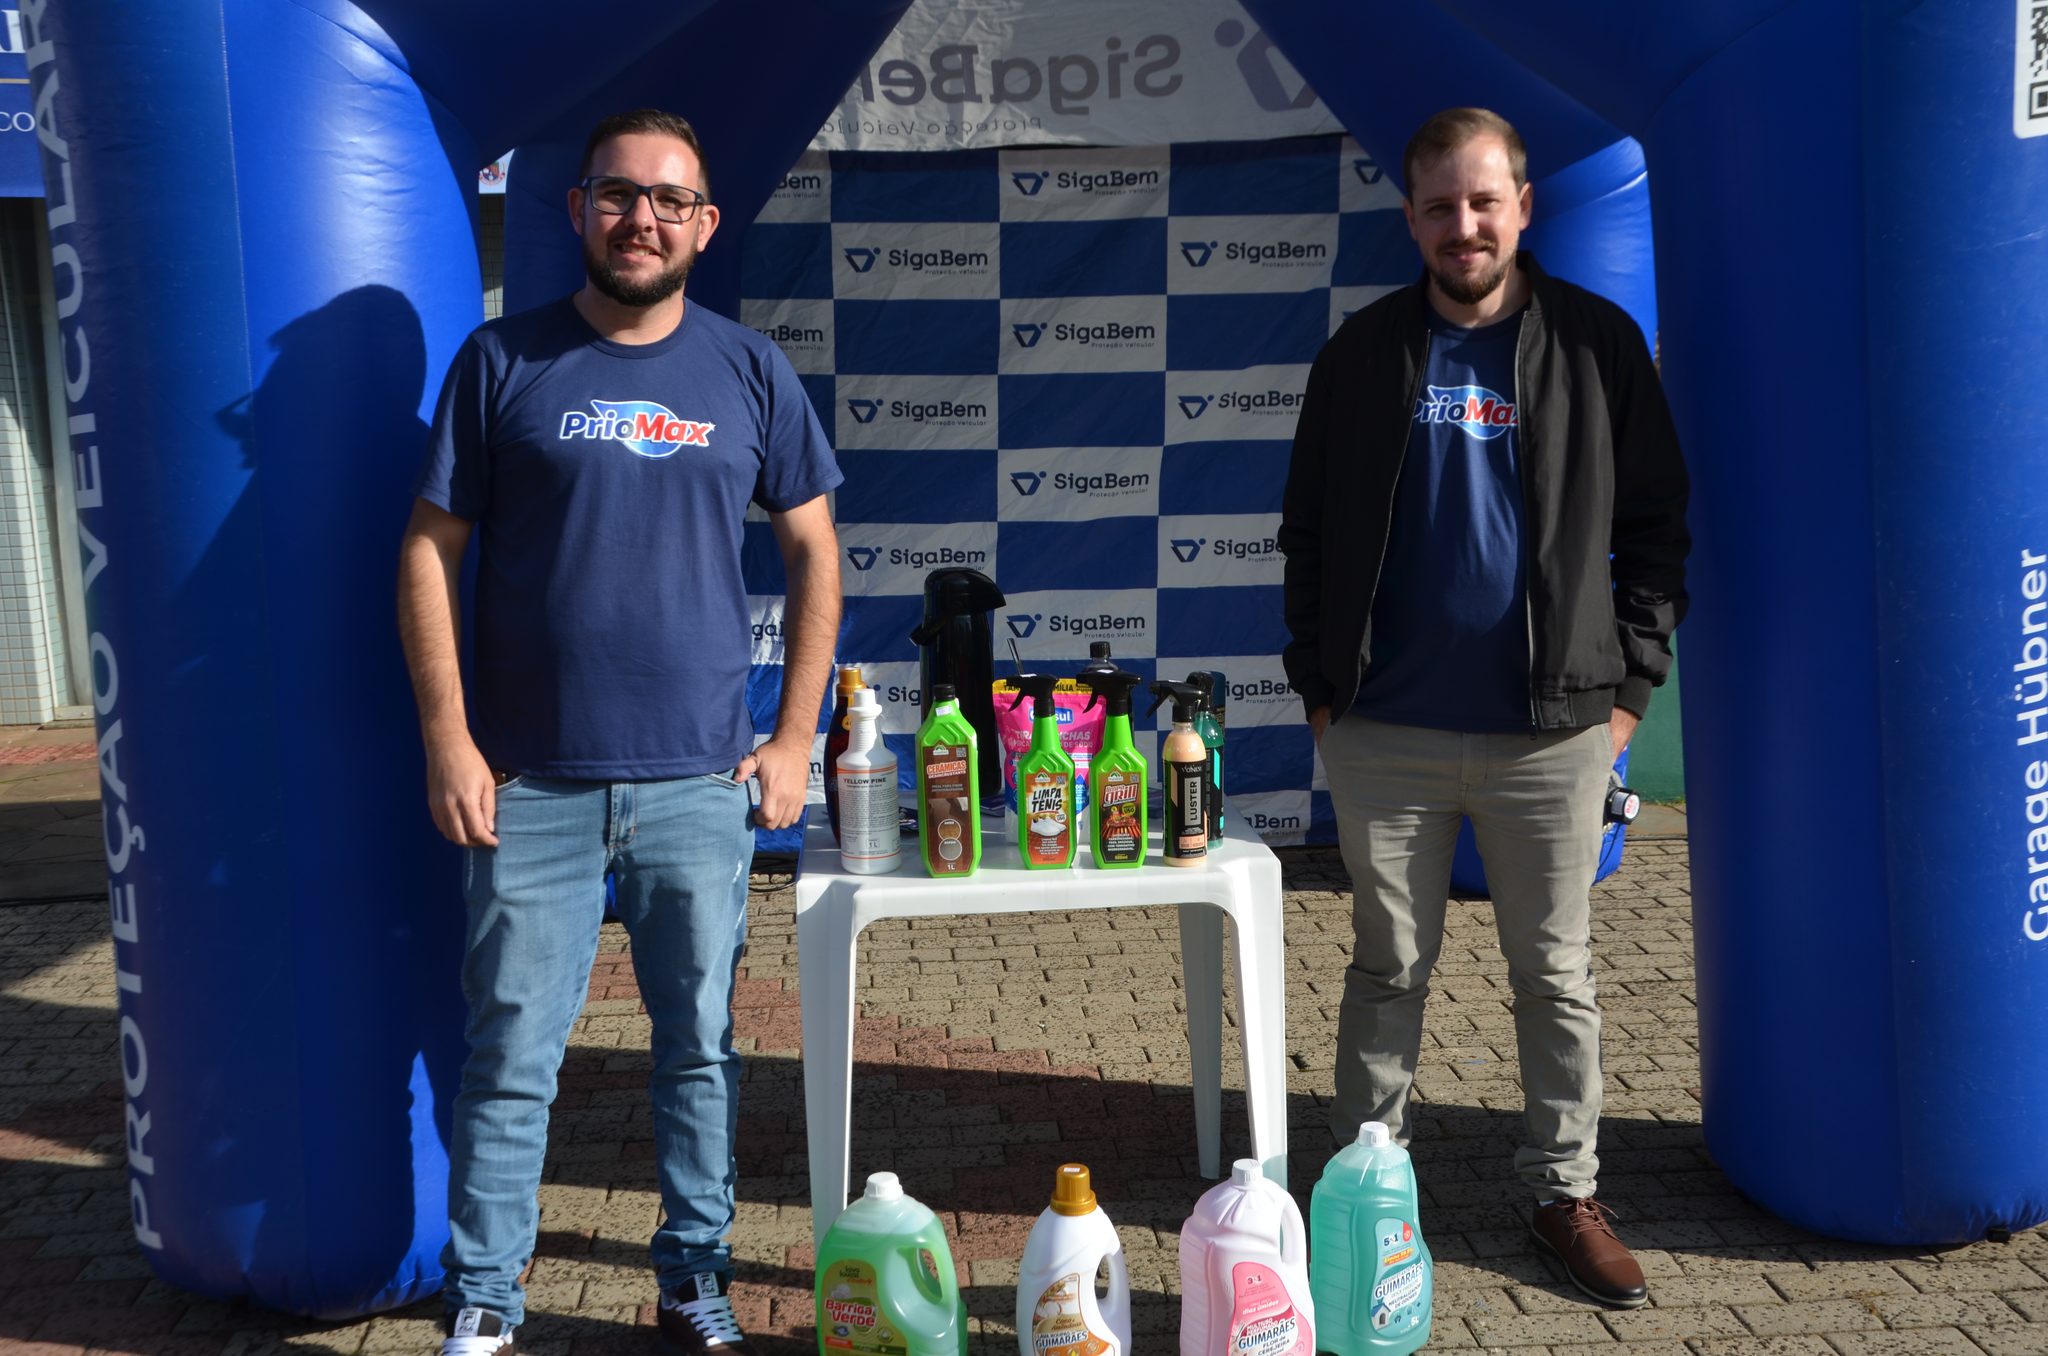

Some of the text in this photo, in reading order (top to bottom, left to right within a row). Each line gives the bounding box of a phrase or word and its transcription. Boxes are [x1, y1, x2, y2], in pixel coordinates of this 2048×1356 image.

[1057, 170, 1158, 193] SigaBem
[888, 248, 988, 271] SigaBem
[1226, 241, 1326, 264] SigaBem
[1055, 322, 1155, 344] SigaBem
[891, 400, 987, 422] SigaBem
[560, 409, 711, 448] PrioMax
[1054, 472, 1149, 493] SigaBem
[889, 547, 986, 569] SigaBem
[1213, 537, 1283, 559] SigaB
[1049, 614, 1145, 635] SigaBem
[2012, 547, 2047, 747] Hübner
[1225, 679, 1291, 701] igaBe
[1033, 787, 1061, 800] LIMPA
[1190, 781, 1198, 821] LUSTER
[1032, 799, 1062, 813] TENIS
[1375, 1262, 1423, 1299] GUIMARÃES
[824, 1298, 874, 1316] Barriga
[831, 1310, 876, 1328] Verde
[1238, 1317, 1296, 1350] GUIMARÃES
[1262, 1338, 1279, 1349] FLOR
